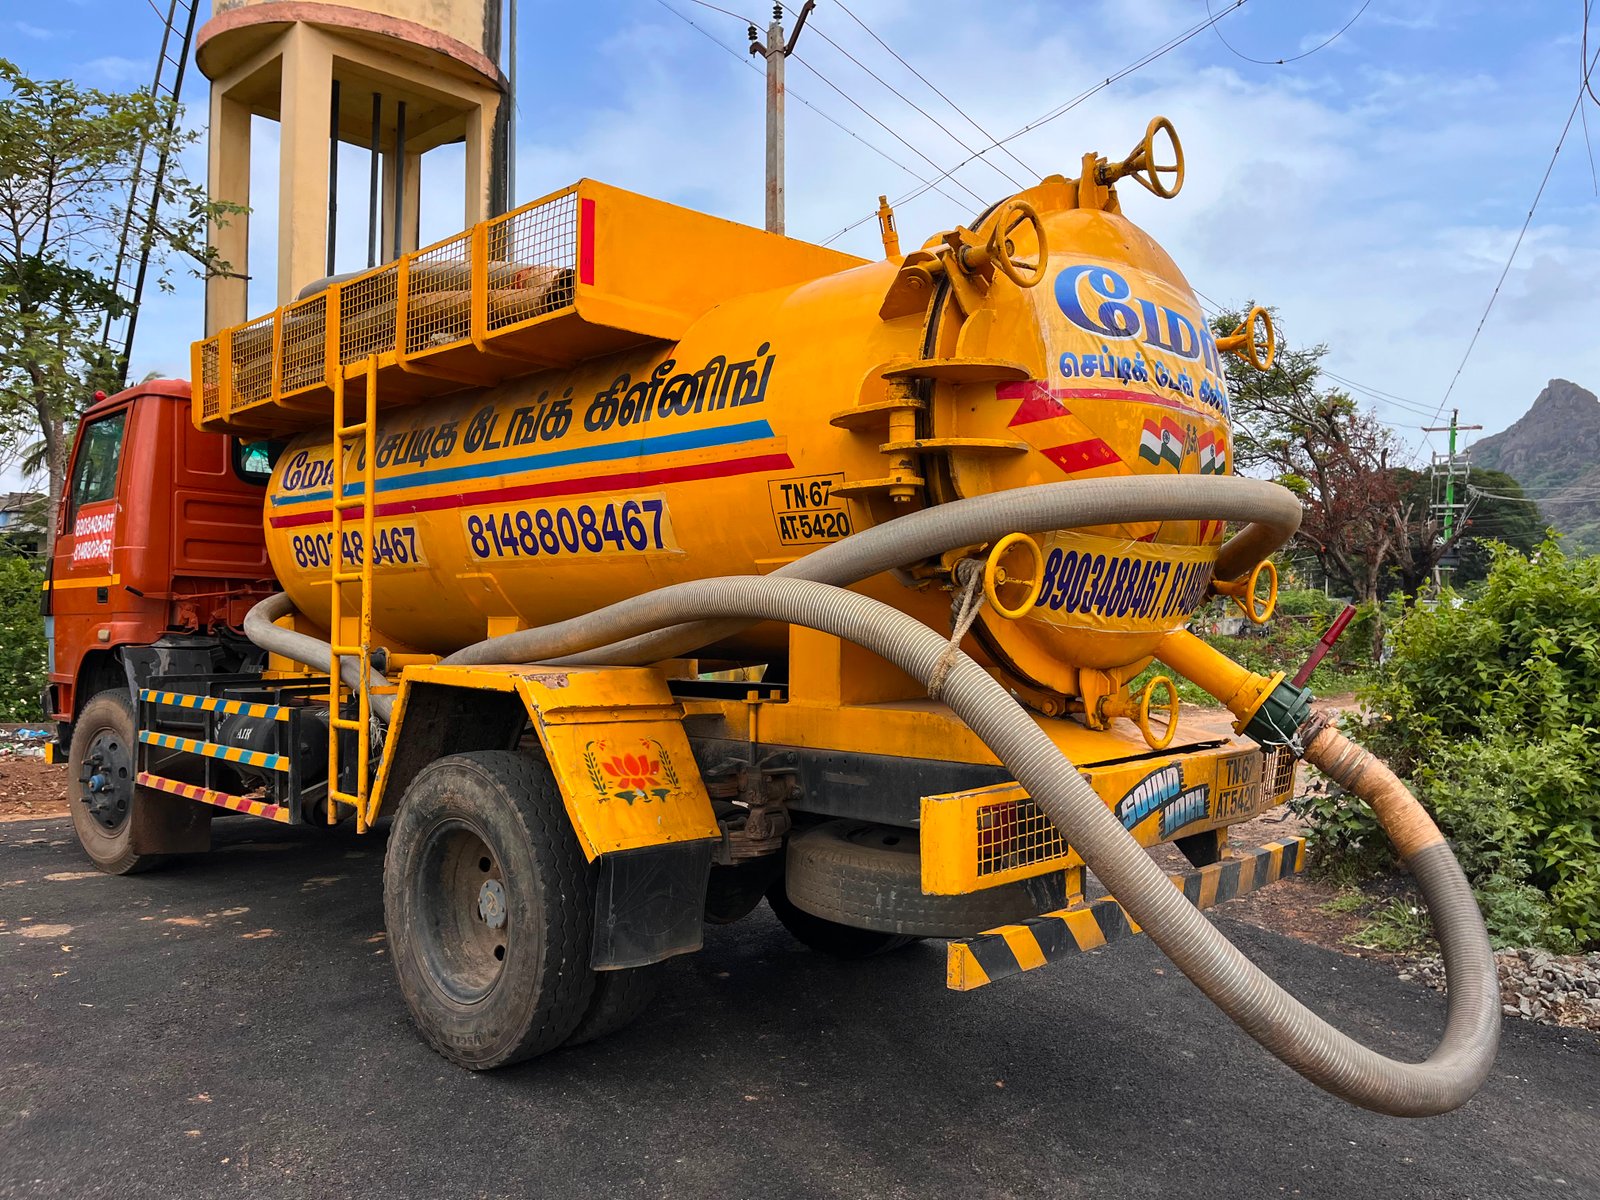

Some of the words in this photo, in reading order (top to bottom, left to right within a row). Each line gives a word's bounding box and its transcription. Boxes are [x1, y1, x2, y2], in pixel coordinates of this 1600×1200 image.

[1059, 344, 1149, 386] செப்டிக்
[462, 386, 574, 454] டேங்க்
[583, 342, 776, 432] கிளீனிங்
[467, 499, 664, 558] 8148808467
[1120, 767, 1180, 832] SOUND
[1164, 788, 1205, 836] HORN
